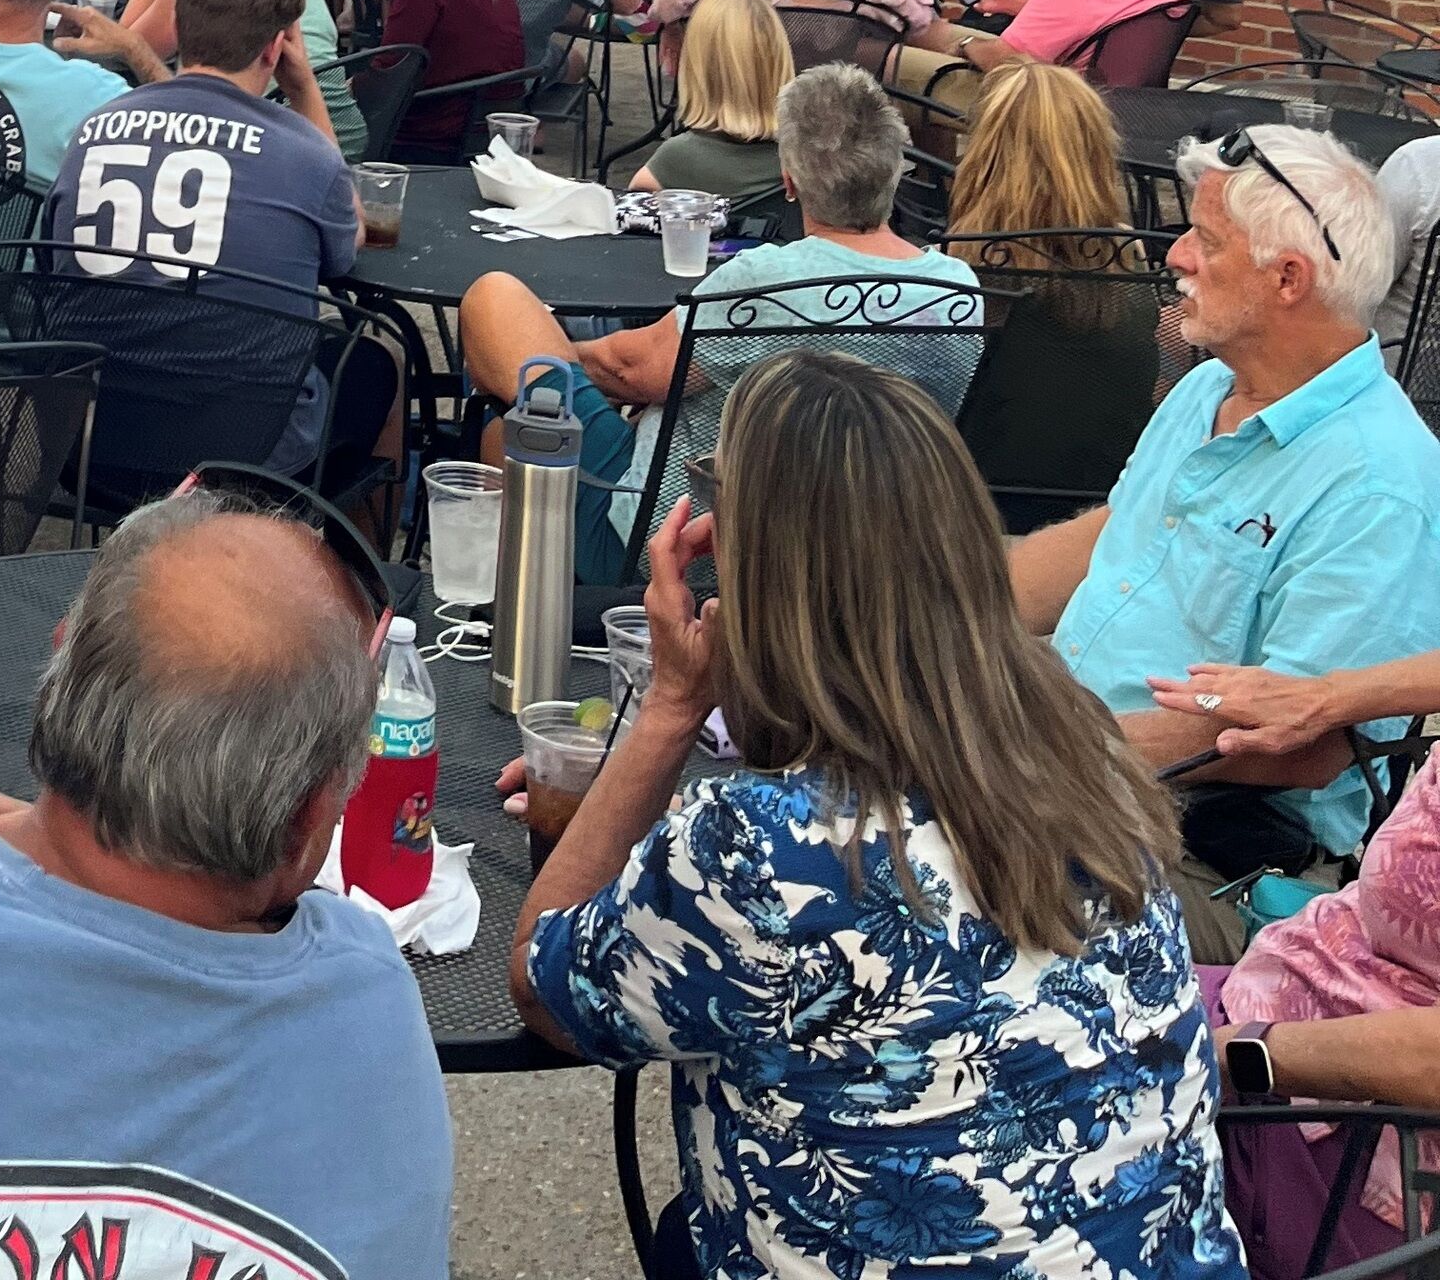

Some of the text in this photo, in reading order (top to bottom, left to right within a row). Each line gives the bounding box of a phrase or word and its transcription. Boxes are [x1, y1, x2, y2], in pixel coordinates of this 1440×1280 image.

[0, 114, 23, 173] CRAB
[78, 110, 265, 155] STOPPKOTTE
[73, 144, 232, 279] 59
